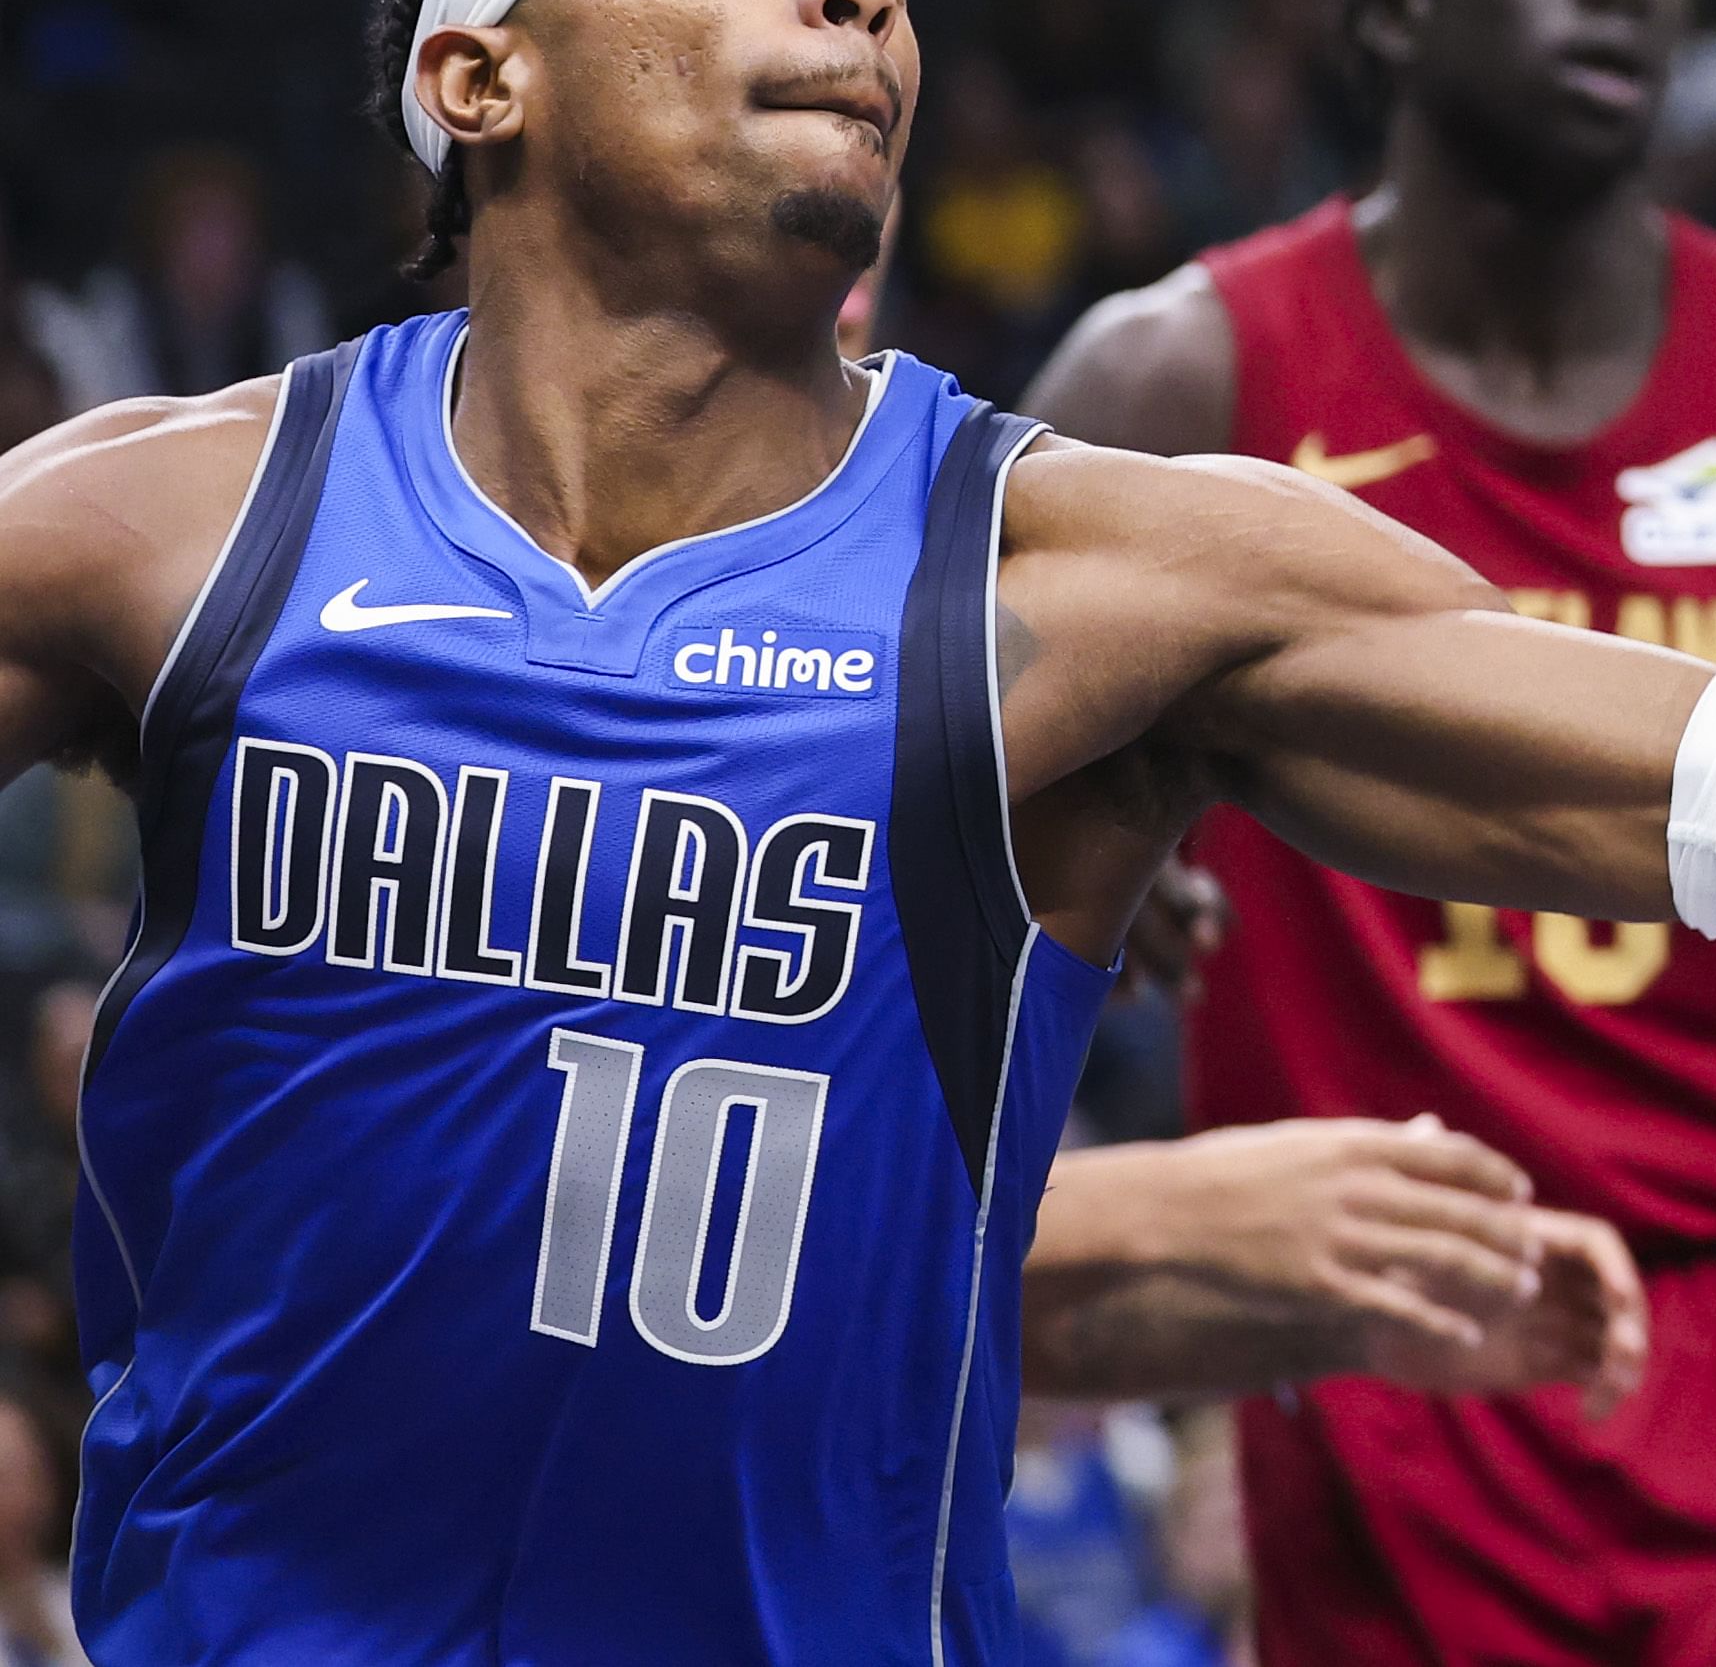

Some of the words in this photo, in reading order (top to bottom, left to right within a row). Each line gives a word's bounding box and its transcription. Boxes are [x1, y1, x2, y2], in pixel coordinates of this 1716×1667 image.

[673, 628, 875, 694] chime
[231, 736, 876, 1024] DALLAS
[530, 1028, 831, 1366] 10
